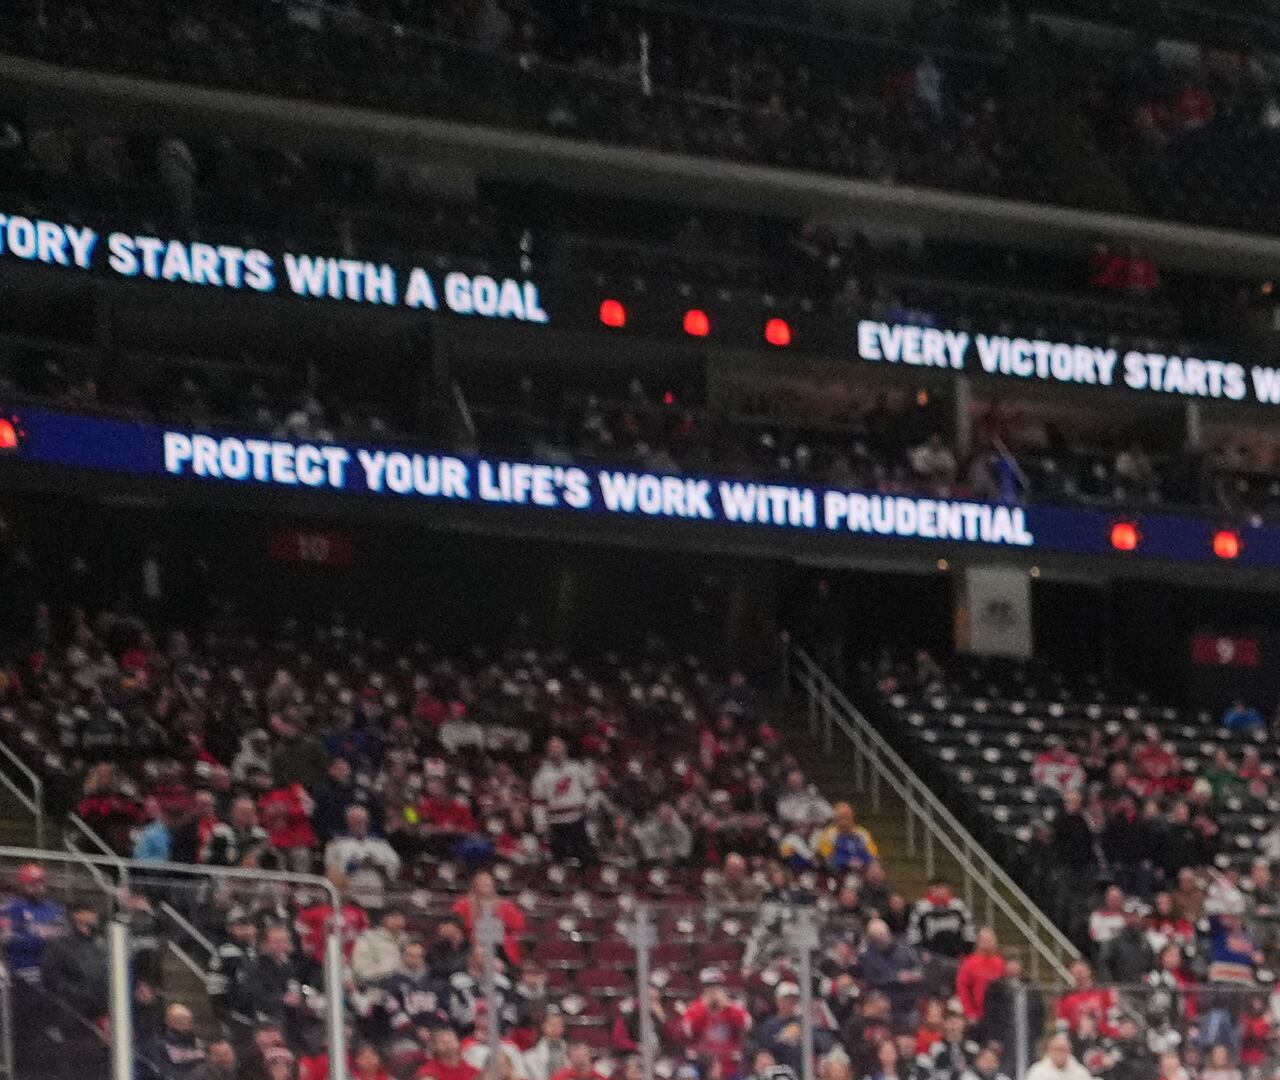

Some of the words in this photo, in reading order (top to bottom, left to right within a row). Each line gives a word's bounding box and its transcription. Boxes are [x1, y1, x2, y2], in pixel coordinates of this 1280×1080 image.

[109, 233, 274, 291] STARTS
[284, 254, 396, 305] WITH
[405, 268, 436, 309] A
[445, 273, 547, 322] GOAL
[858, 320, 968, 369] EVERY
[976, 334, 1117, 385] VICTORY
[1124, 352, 1246, 399] STARTS
[164, 432, 350, 487] PROTECT
[358, 450, 470, 498] YOUR
[479, 460, 591, 508] LIFE'S
[599, 471, 713, 519] WORK
[719, 482, 816, 527] WITH
[824, 491, 1033, 545] PRUDENTIAL
